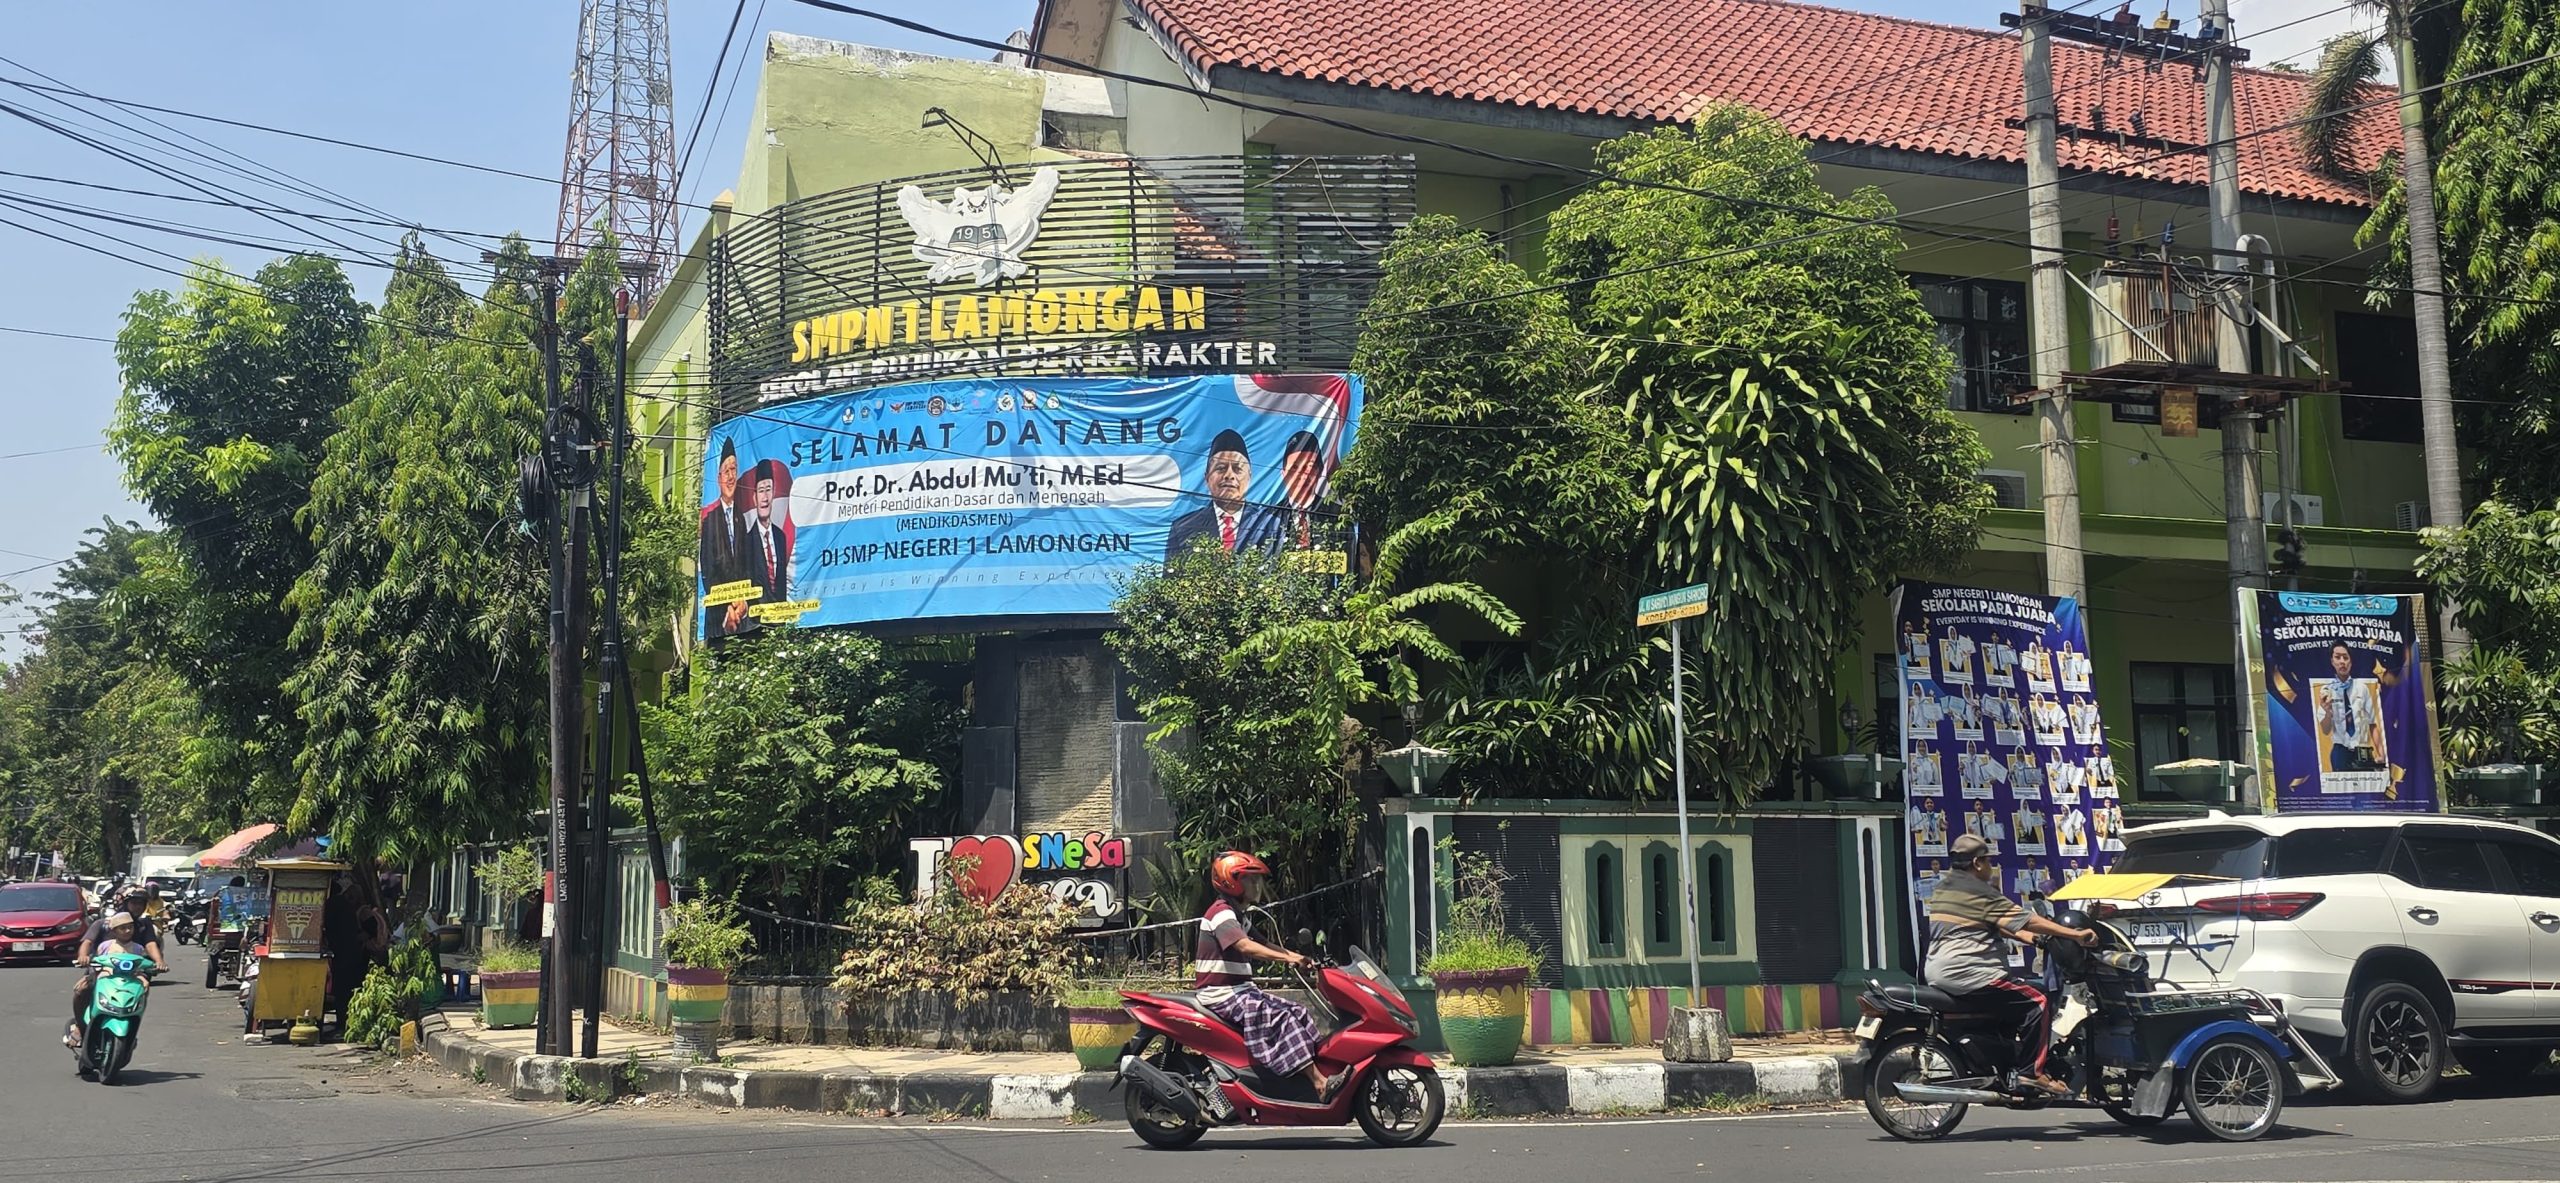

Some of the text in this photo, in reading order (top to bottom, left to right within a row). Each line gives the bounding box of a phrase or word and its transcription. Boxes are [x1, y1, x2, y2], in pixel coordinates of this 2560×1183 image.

[956, 228, 974, 239] 19
[791, 286, 1206, 364] SMPN 1 LAMONGAN
[790, 416, 1182, 468] SELAMAT DATANG
[826, 475, 868, 501] Prof.
[873, 474, 903, 496] Dr.
[908, 466, 977, 492] Abdul
[1061, 463, 1124, 487] M.Ed
[838, 489, 1105, 518] Menteri Pendidikan Dasar dan Menengah
[896, 511, 1014, 533] (MENDIKDASMEN)
[822, 533, 1131, 567] DI SMP NEGERI 1 LAMONGAN
[880, 579, 896, 587] is
[911, 571, 999, 585] Winning
[1932, 588, 1952, 599] SMP
[1953, 588, 1984, 600] NEGERI
[1991, 590, 2043, 610] LAMONGAN
[1921, 599, 2057, 625] SEKOLAH PARA JUARA
[1936, 616, 1970, 626] EVERYDAY
[2284, 616, 2304, 627] SMP
[2304, 615, 2335, 626] NEGERI
[2340, 615, 2391, 630] LAMONGAN
[2273, 625, 2330, 640] SEKOLAH
[2330, 625, 2364, 639] PARA
[2364, 627, 2404, 644] JUARA
[2288, 640, 2321, 652] EVERYDAY
[277, 891, 325, 905] CILOK
[2144, 925, 2161, 937] 533
